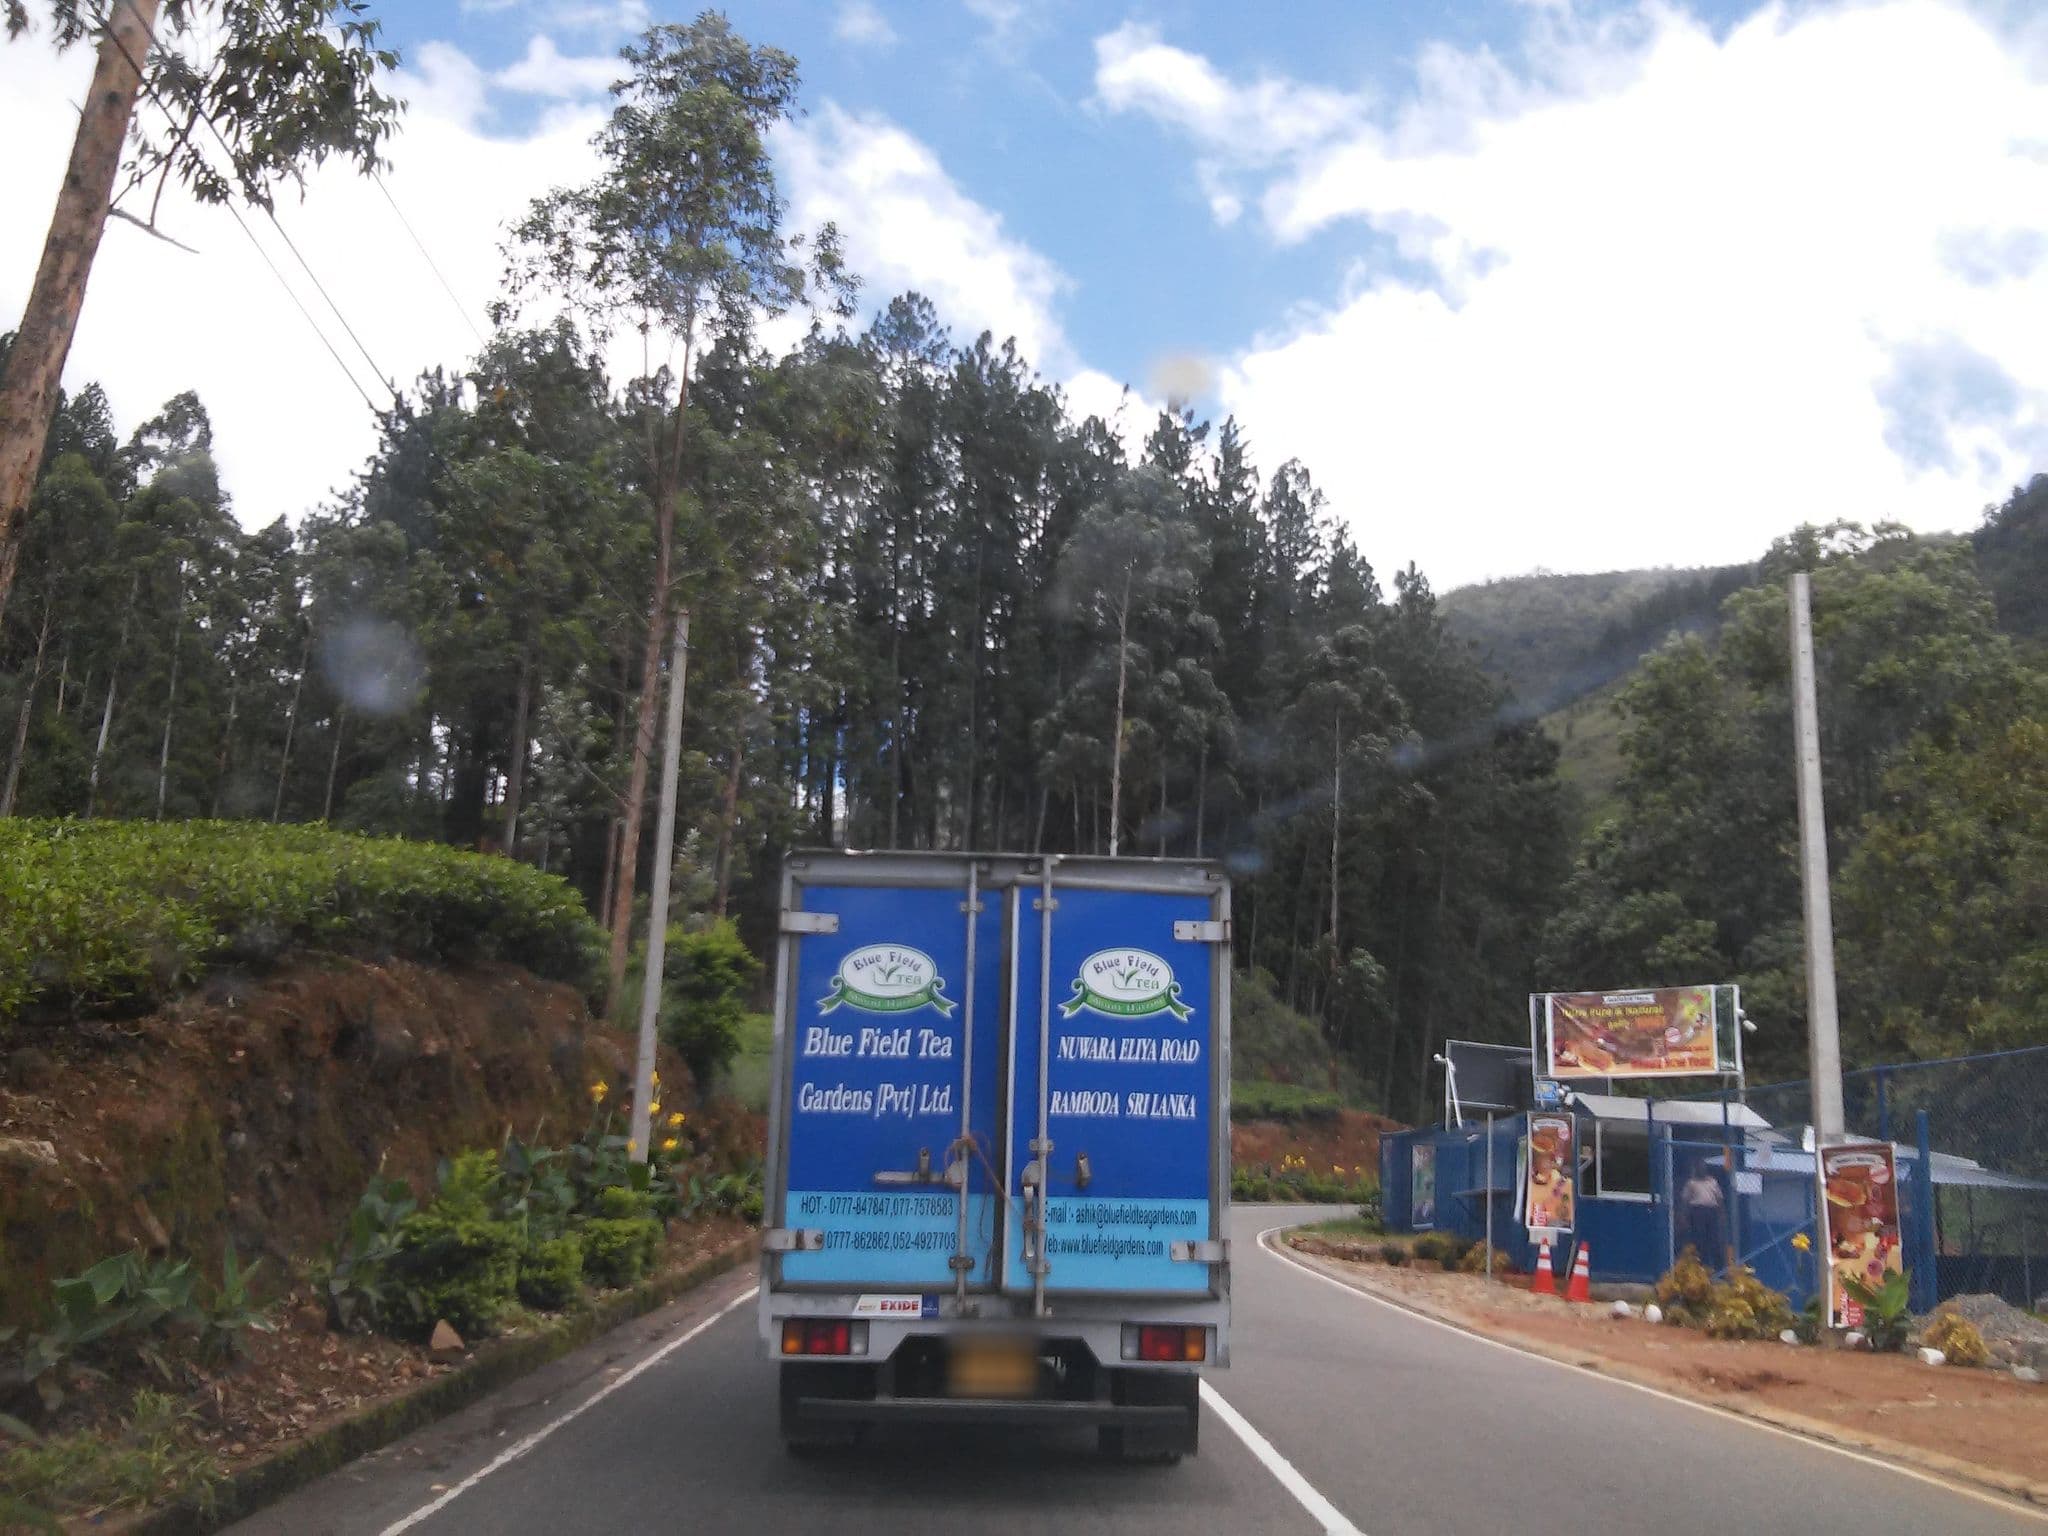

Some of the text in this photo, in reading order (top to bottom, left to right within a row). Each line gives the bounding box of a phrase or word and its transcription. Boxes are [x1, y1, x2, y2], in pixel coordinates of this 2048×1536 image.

[853, 951, 922, 973] Blue Field
[1093, 955, 1160, 977] Blue Field
[1136, 978, 1160, 990] TEA
[804, 1026, 953, 1057] Blue Field Tea
[1057, 1036, 1201, 1062] NUWARA ELIYA ROAD
[800, 1082, 873, 1112] Gardens
[919, 1084, 954, 1112] Ltd.
[1050, 1090, 1197, 1117] RAMBODA SRI LANKA
[1044, 1233, 1164, 1260] eb:www.bluefieldgardens.com
[880, 1300, 919, 1311] EXIDE
